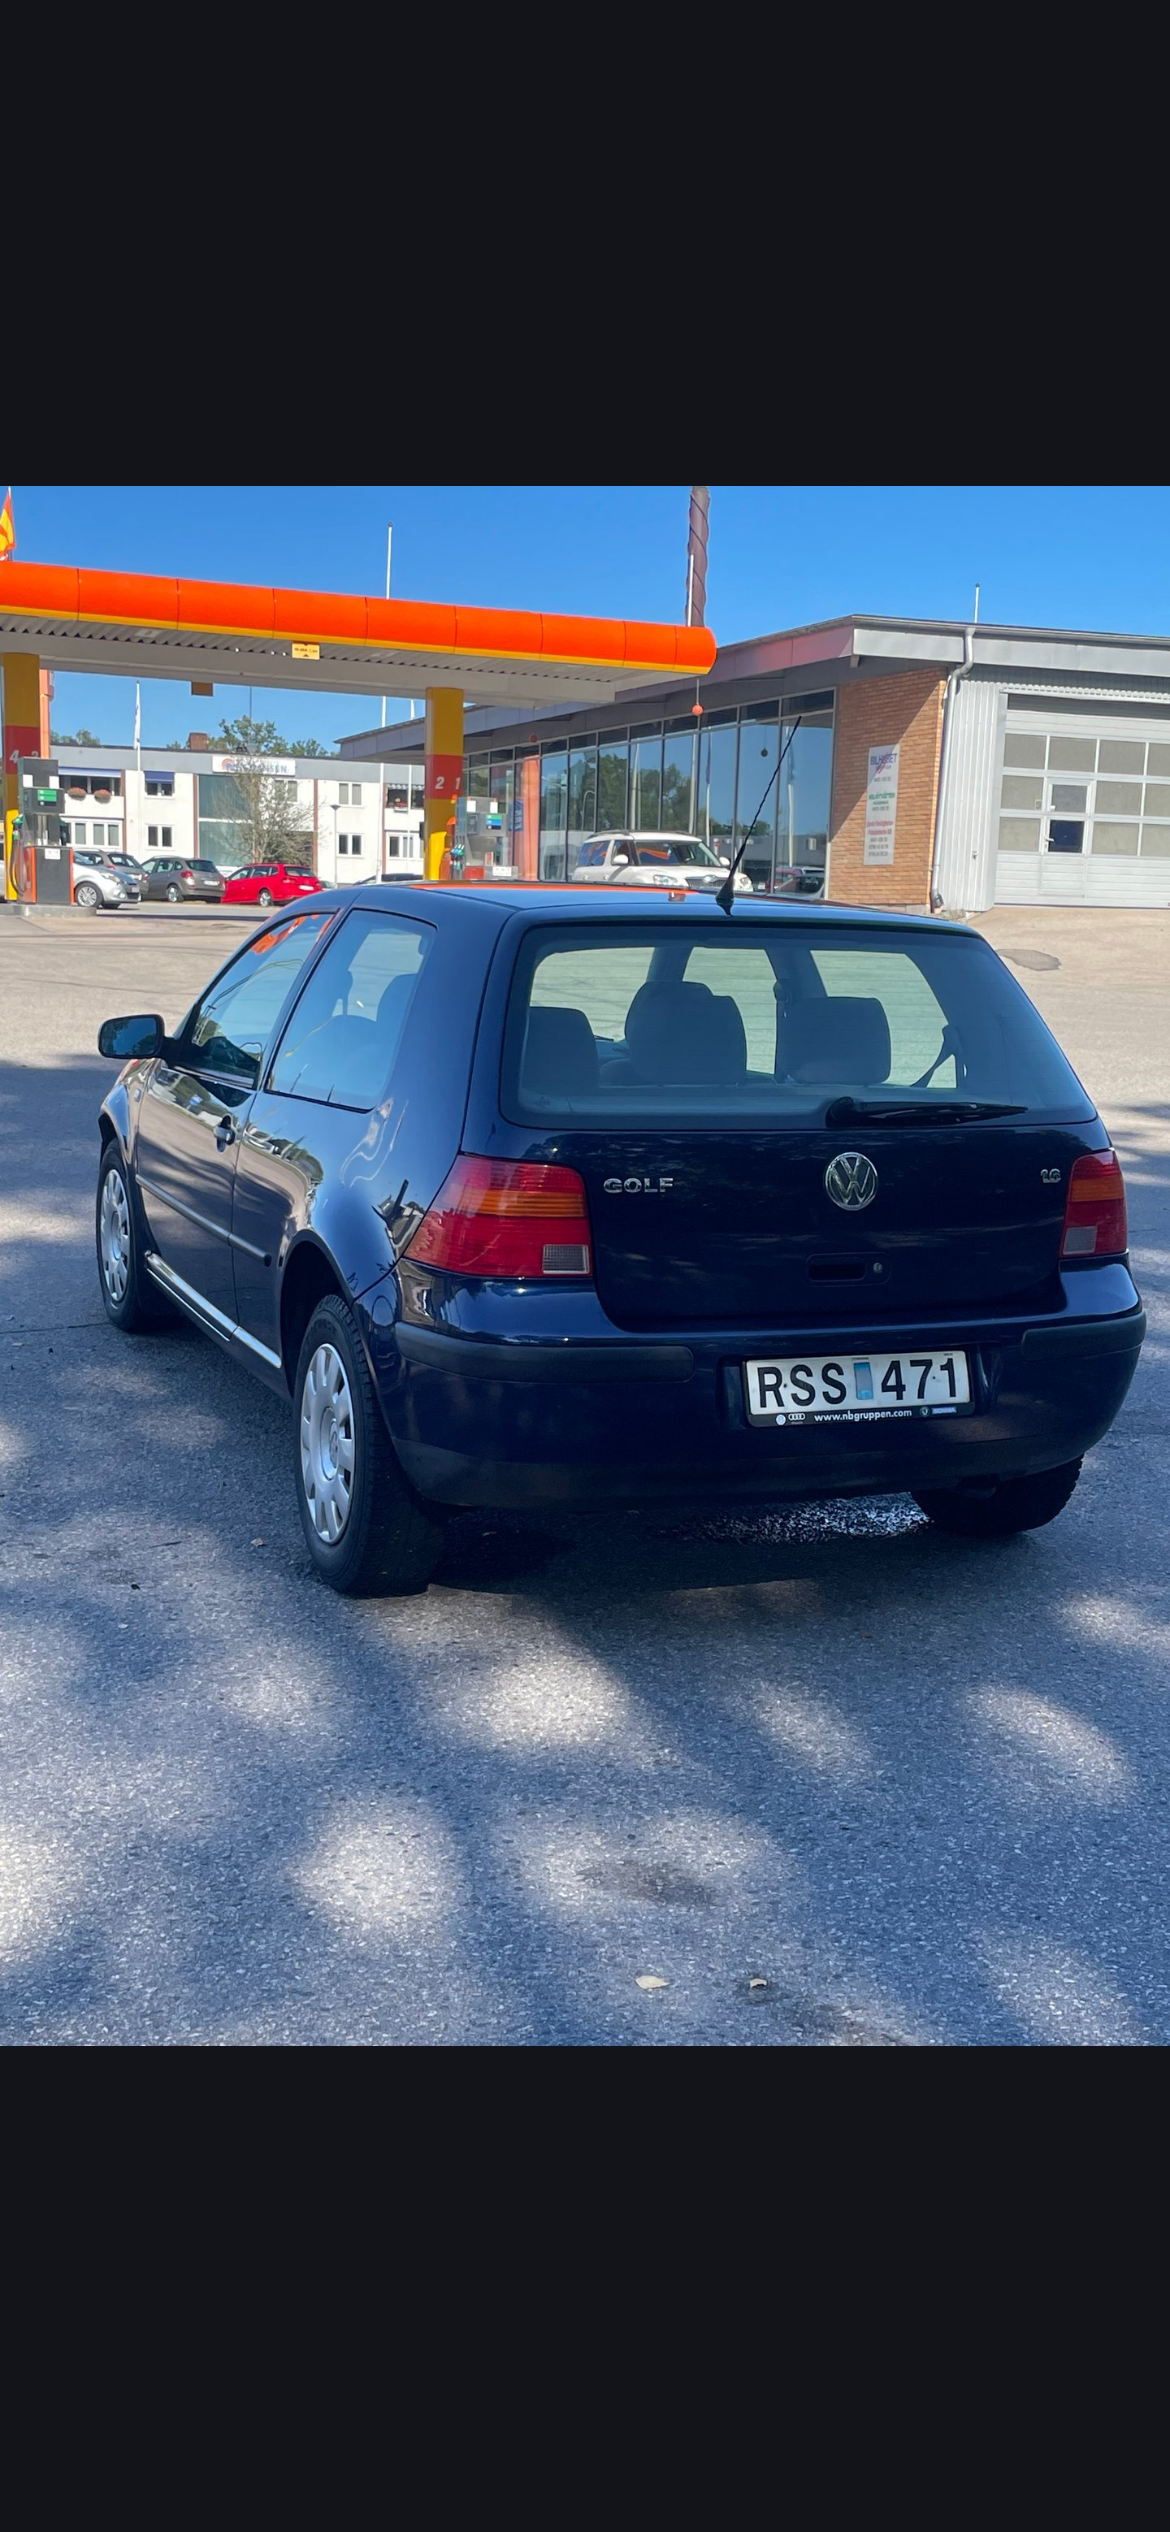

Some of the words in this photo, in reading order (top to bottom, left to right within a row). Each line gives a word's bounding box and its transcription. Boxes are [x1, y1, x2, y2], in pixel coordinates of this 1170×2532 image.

[9, 750, 20, 764] 4
[435, 776, 445, 790] 2
[455, 777, 461, 790] 1
[603, 1177, 674, 1194] GOLF
[757, 1362, 848, 1409] RSS
[881, 1357, 957, 1402] 471
[814, 1409, 913, 1422] www.nbgruppen.com
